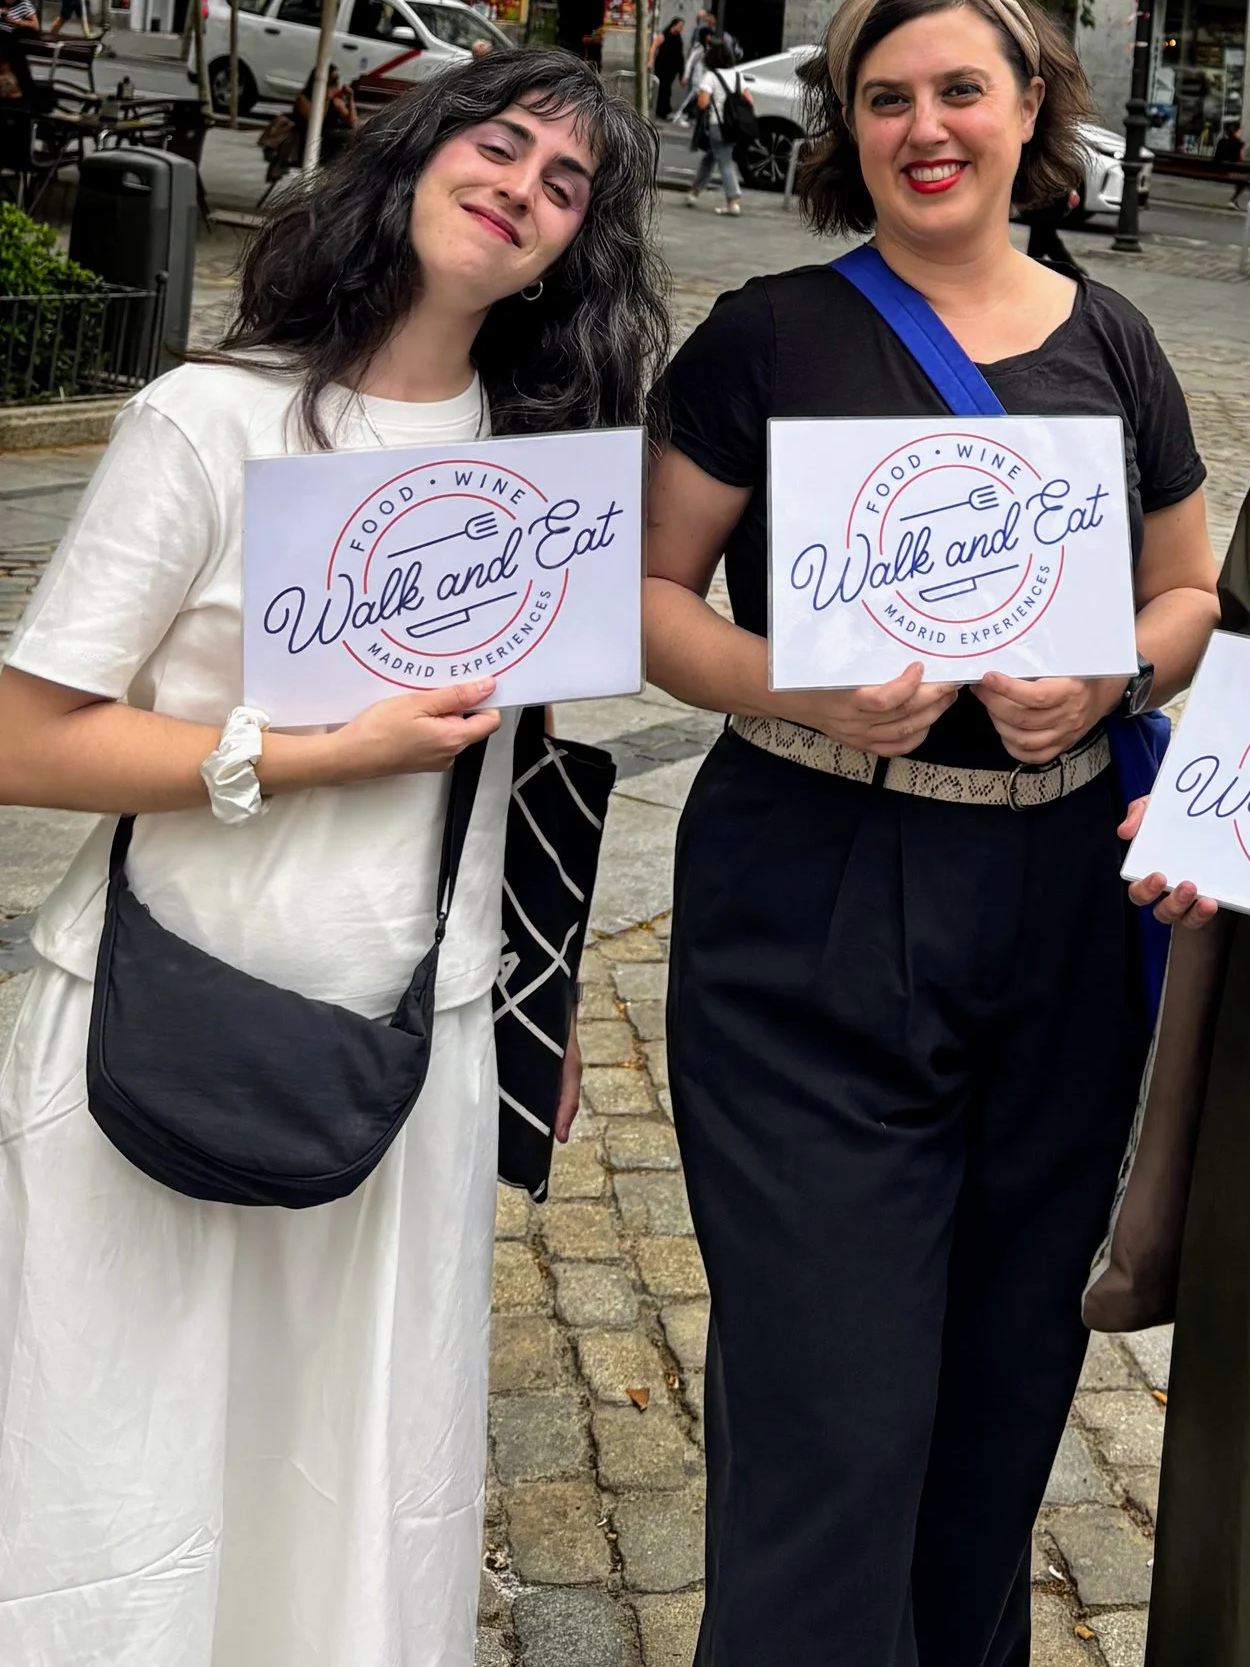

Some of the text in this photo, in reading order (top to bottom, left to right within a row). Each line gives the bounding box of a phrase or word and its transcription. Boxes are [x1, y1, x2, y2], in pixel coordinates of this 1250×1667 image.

[350, 470, 526, 552] FOOD WINE
[866, 443, 1021, 514] FOOD WINE
[263, 499, 624, 654] Walk and Eat
[791, 479, 1109, 611] Walk and Eat
[367, 590, 552, 679] MADRID EXPERIENCES
[884, 564, 1050, 645] MADRID EXPERIENCES
